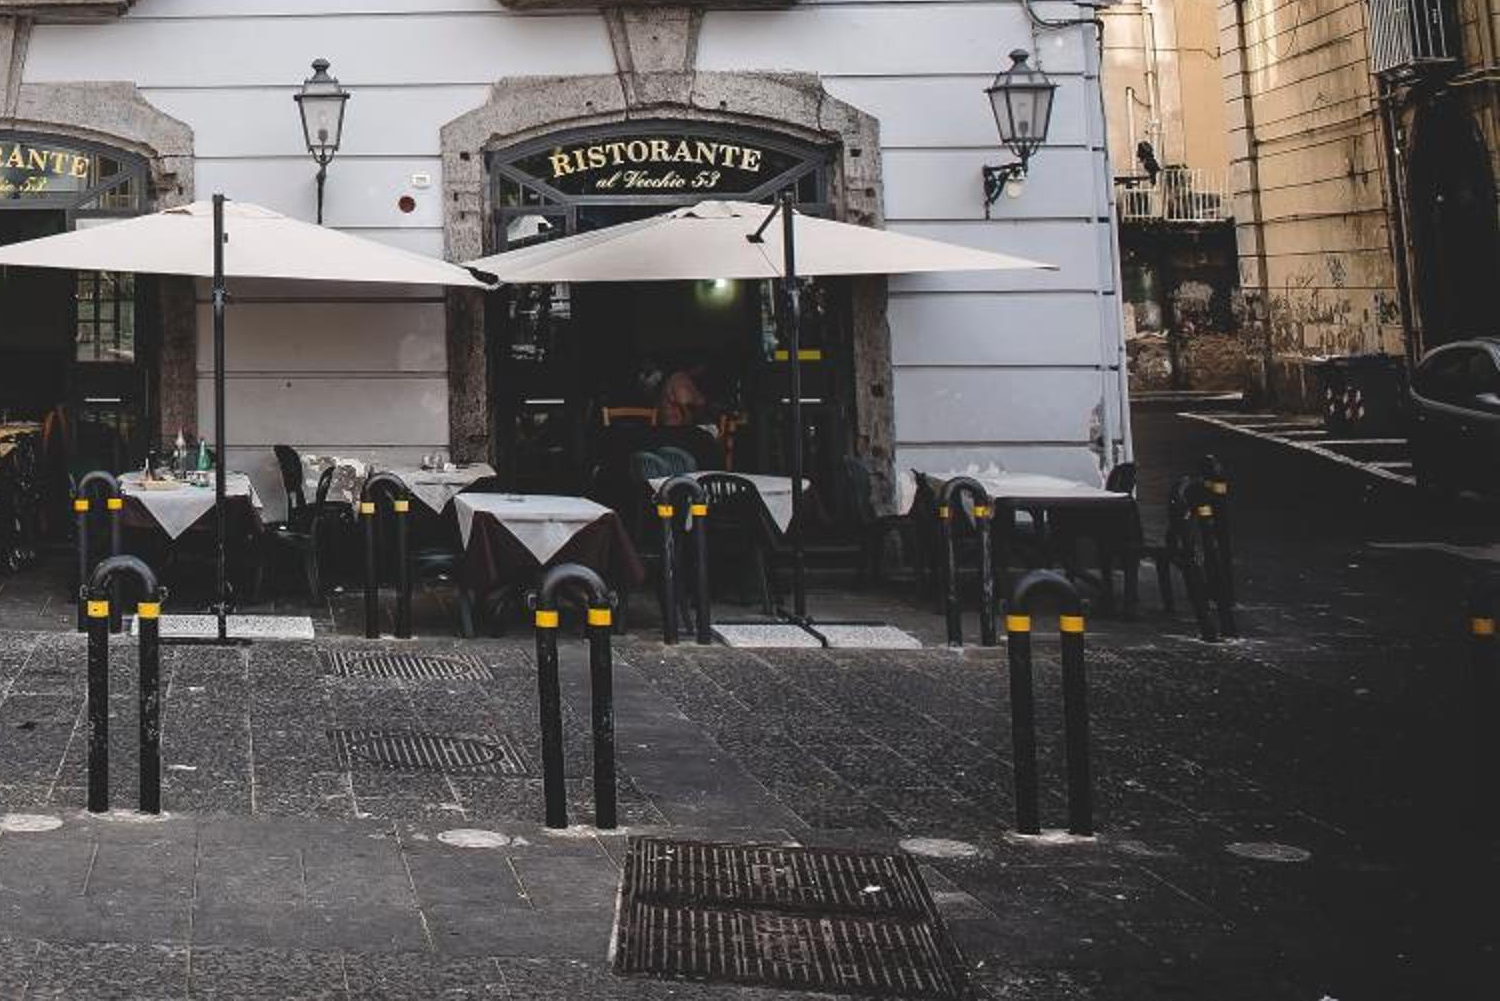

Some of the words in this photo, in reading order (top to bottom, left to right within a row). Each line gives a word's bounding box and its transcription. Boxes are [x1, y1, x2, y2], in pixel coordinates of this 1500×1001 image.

[549, 140, 762, 178] RISTORANTE
[19, 176, 48, 192] 53
[596, 171, 620, 188] al
[623, 170, 686, 189] Vecchio
[692, 171, 721, 188] 53
